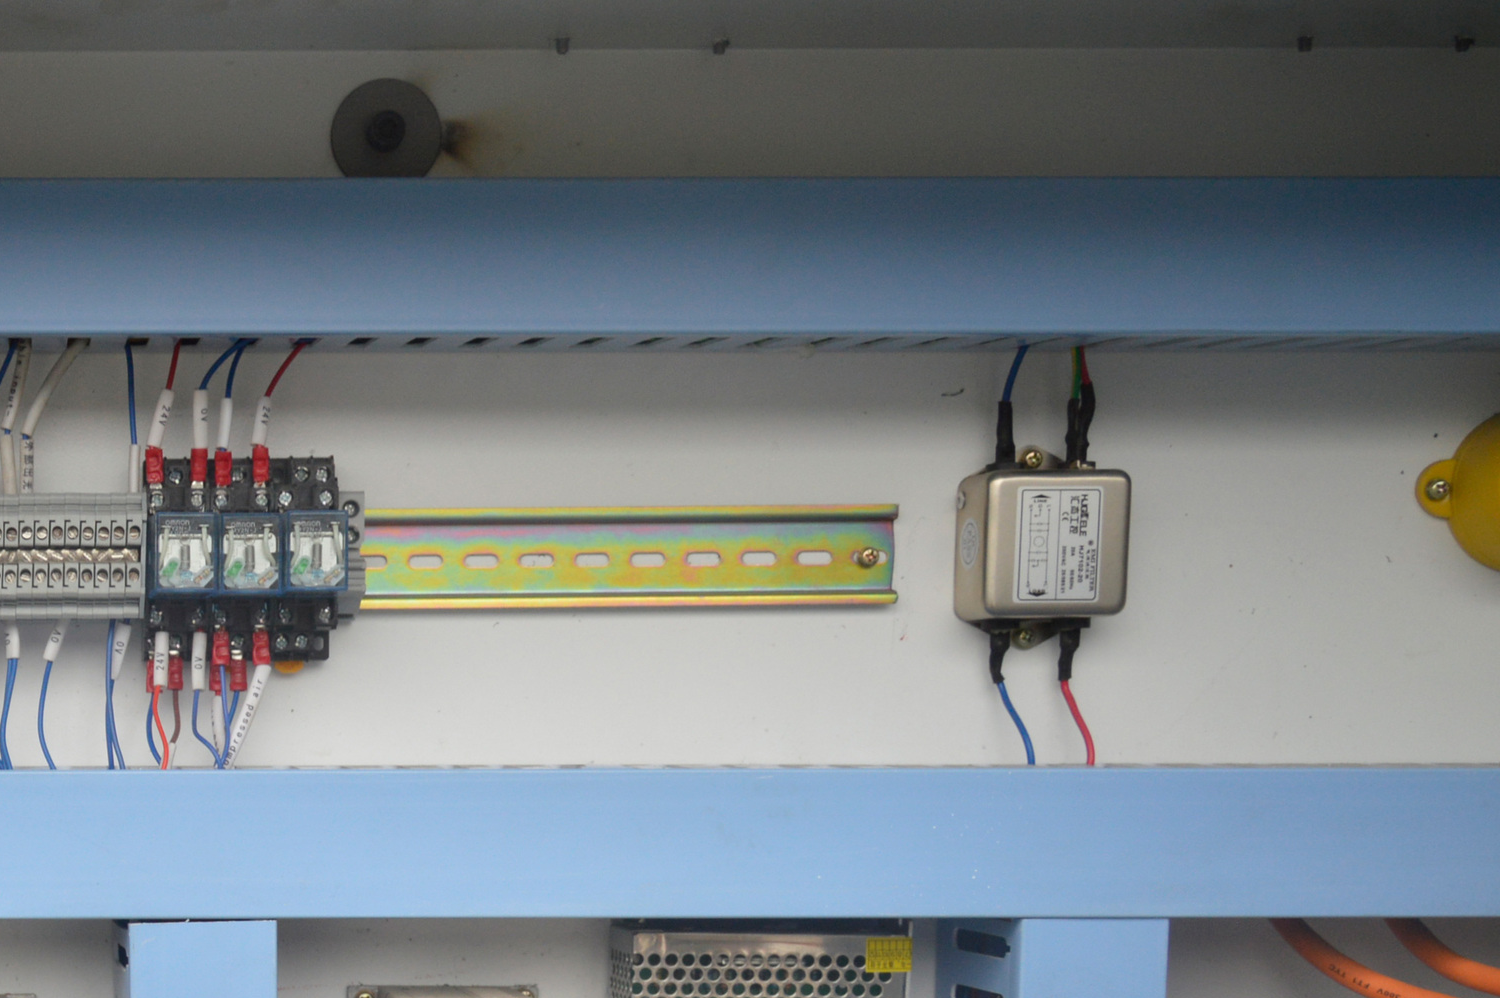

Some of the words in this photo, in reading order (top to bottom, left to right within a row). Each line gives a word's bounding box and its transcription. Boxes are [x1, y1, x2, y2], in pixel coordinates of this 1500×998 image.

[158, 404, 170, 426] 24V
[201, 408, 208, 422] 0V
[261, 406, 270, 425] 24V
[51, 629, 62, 643] 0V
[115, 641, 125, 654] 0V
[156, 652, 165, 670] 24V
[194, 656, 203, 669] 0V
[223, 705, 254, 766] ompressed
[253, 678, 263, 697] air
[1328, 964, 1346, 978] TYC
[1352, 978, 1370, 989] FT1
